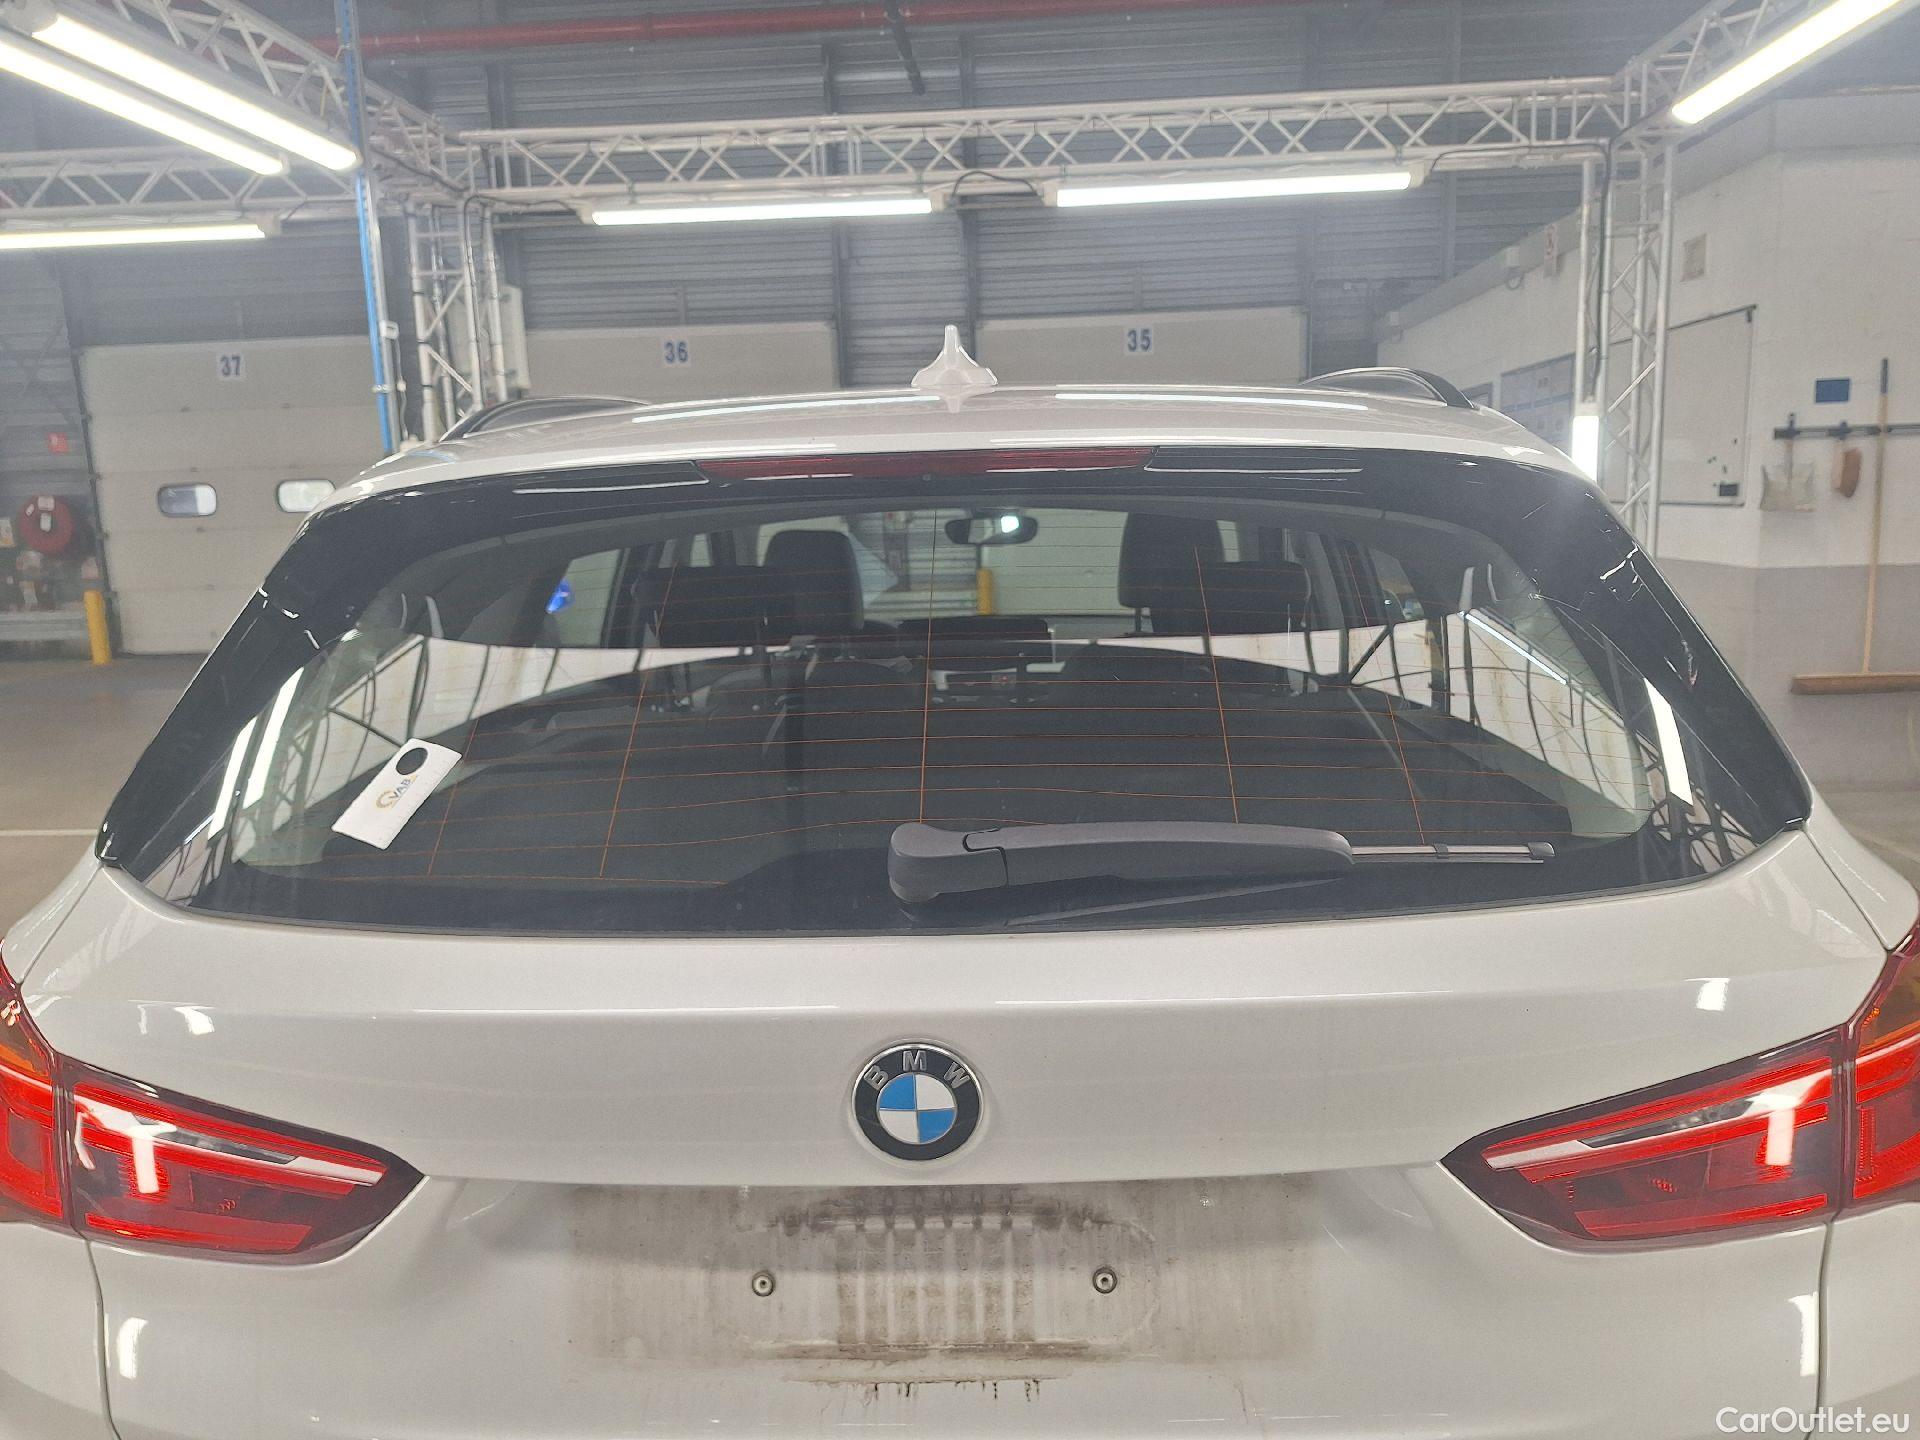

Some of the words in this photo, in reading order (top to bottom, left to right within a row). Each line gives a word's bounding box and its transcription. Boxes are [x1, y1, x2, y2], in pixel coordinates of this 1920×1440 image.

[1127, 328, 1151, 352] 35
[664, 341, 689, 364] 36
[220, 355, 241, 377] 37
[863, 1049, 971, 1091] BMW
